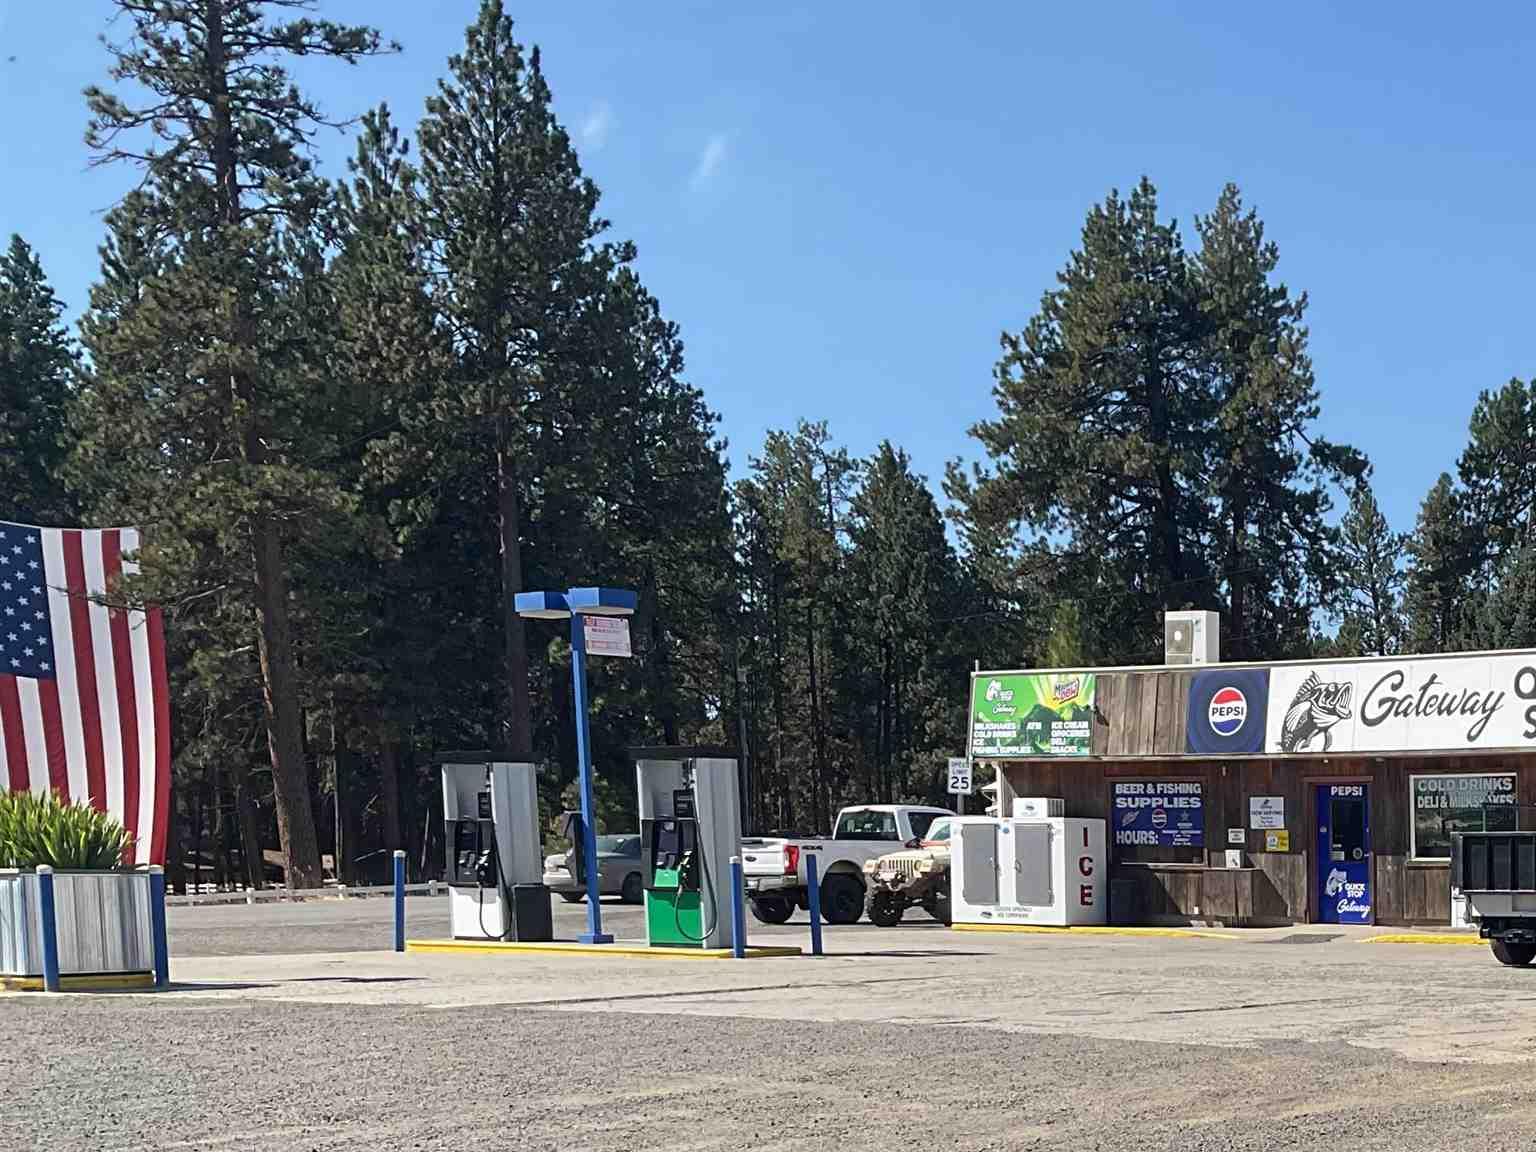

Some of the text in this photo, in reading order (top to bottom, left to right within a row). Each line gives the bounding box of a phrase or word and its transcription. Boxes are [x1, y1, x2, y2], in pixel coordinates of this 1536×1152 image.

[1212, 706, 1244, 717] PEPSI
[1360, 669, 1505, 742] Gateway
[951, 776, 969, 789] 25
[1116, 783, 1201, 794] BEER & FISHING
[1417, 777, 1513, 793] COLD DRINKS
[1331, 786, 1363, 796] PEPSI
[1116, 797, 1201, 808] SUPPLIES
[1417, 795, 1439, 808] DELI
[1440, 797, 1448, 808] &
[1116, 830, 1159, 844] HOURS:
[1079, 827, 1093, 906] ICE
[1345, 883, 1365, 891] QUICK
[1347, 890, 1364, 898] STOP
